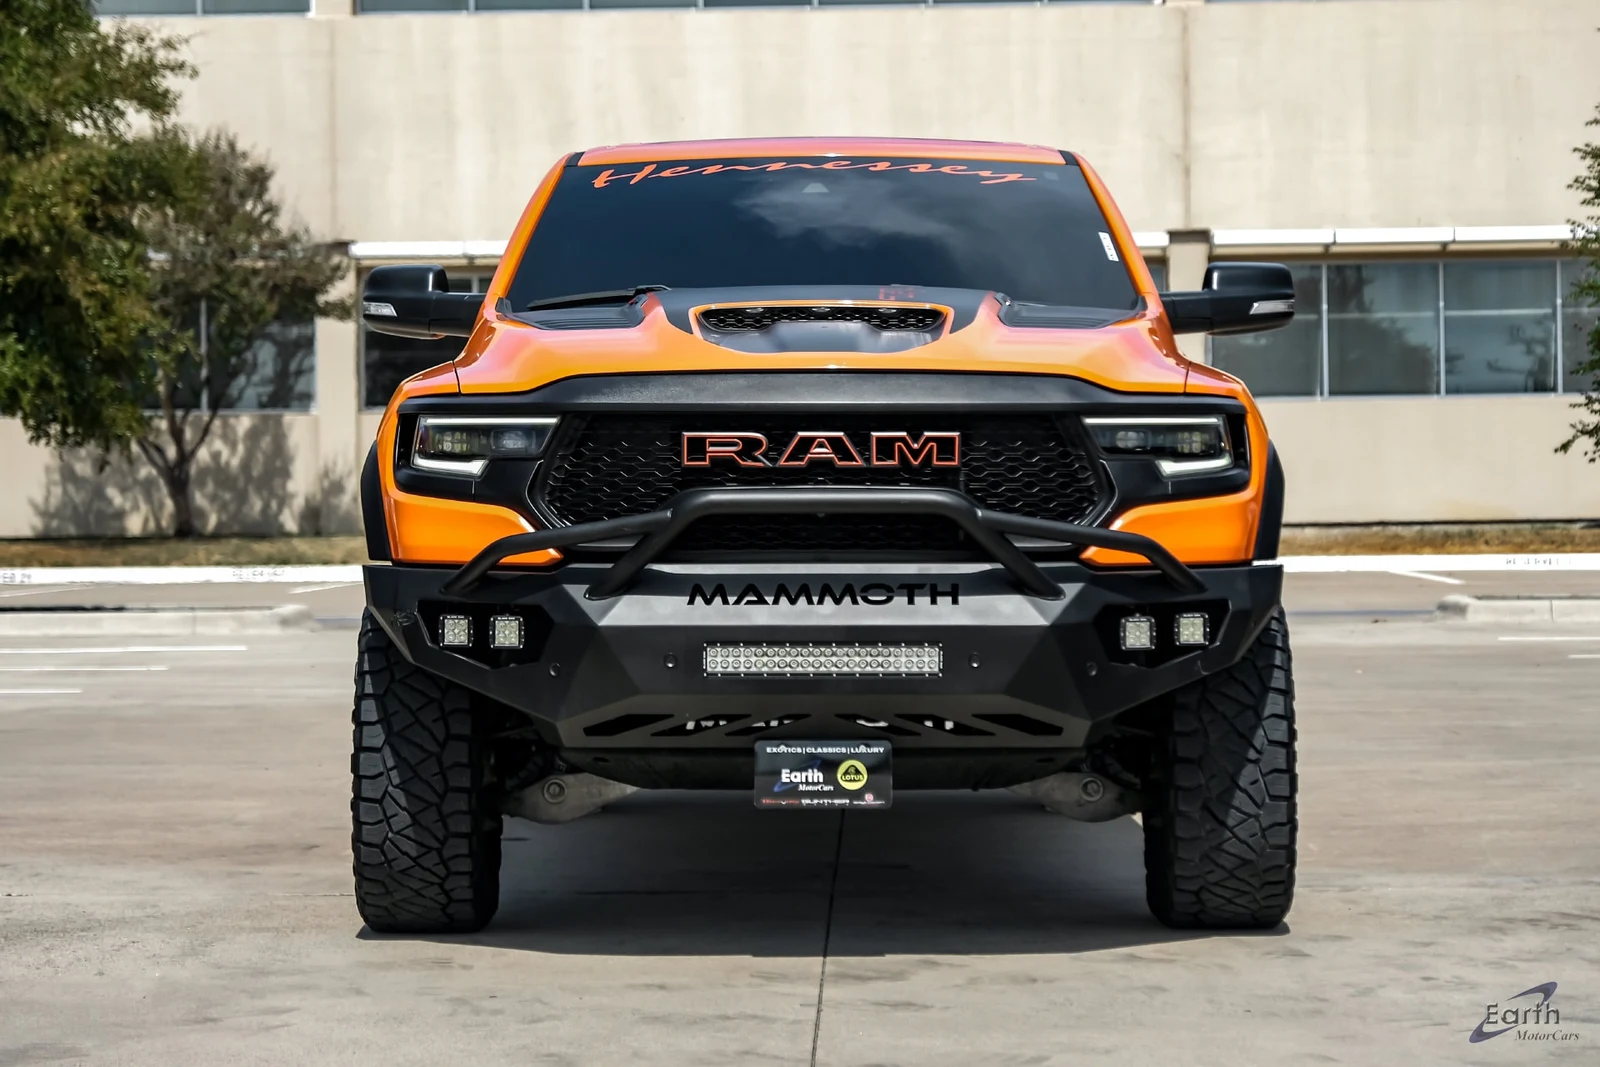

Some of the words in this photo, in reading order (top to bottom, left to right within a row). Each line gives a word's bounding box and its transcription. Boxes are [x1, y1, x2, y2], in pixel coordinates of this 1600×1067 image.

[591, 160, 1038, 189] Hennessey
[682, 431, 961, 467] RAM
[686, 582, 960, 606] MAMMOTH
[781, 768, 824, 783] Earth
[798, 783, 834, 792] MotorCars
